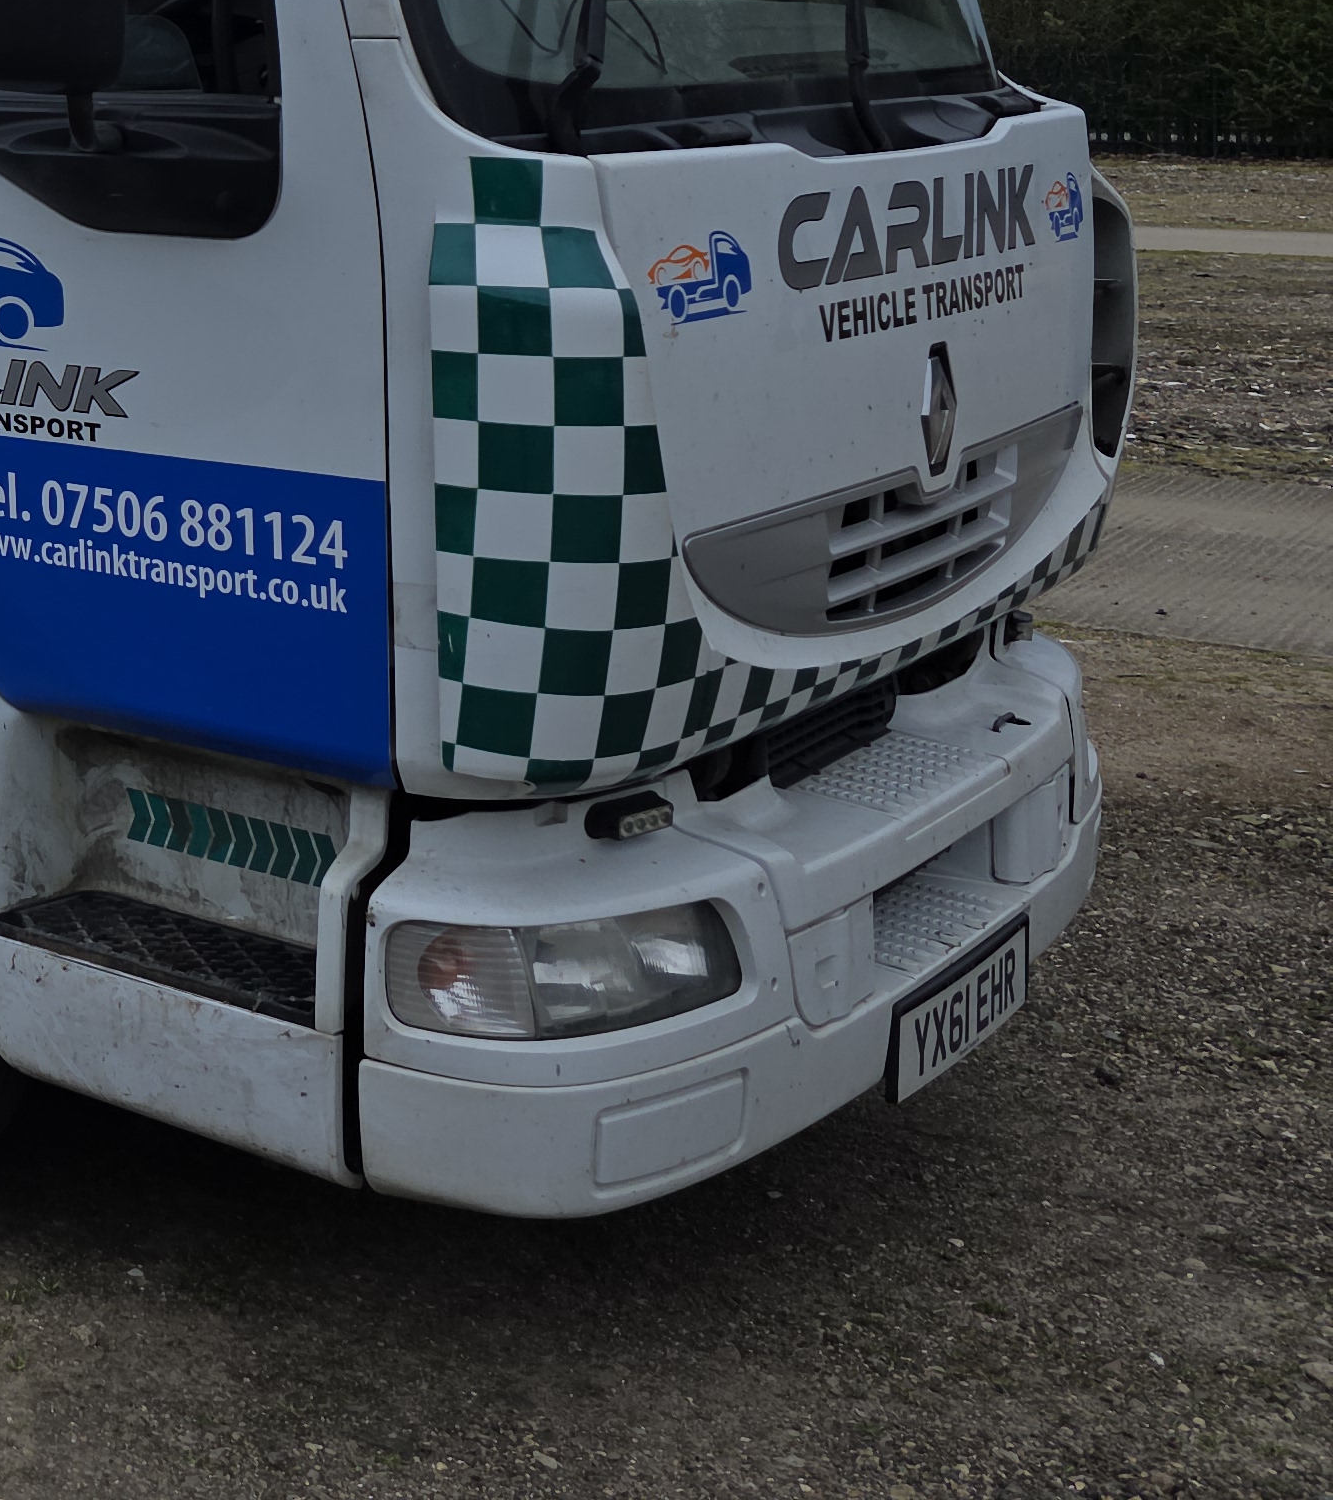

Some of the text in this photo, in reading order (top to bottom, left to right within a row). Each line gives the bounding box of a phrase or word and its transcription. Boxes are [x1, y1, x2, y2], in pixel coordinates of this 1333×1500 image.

[778, 164, 1035, 290] CARLINK
[819, 264, 1024, 342] VEHICLE TRANSPORT
[41, 480, 168, 542] 07506
[180, 499, 348, 569] 881124
[914, 948, 1015, 1076] YX61 EHR
